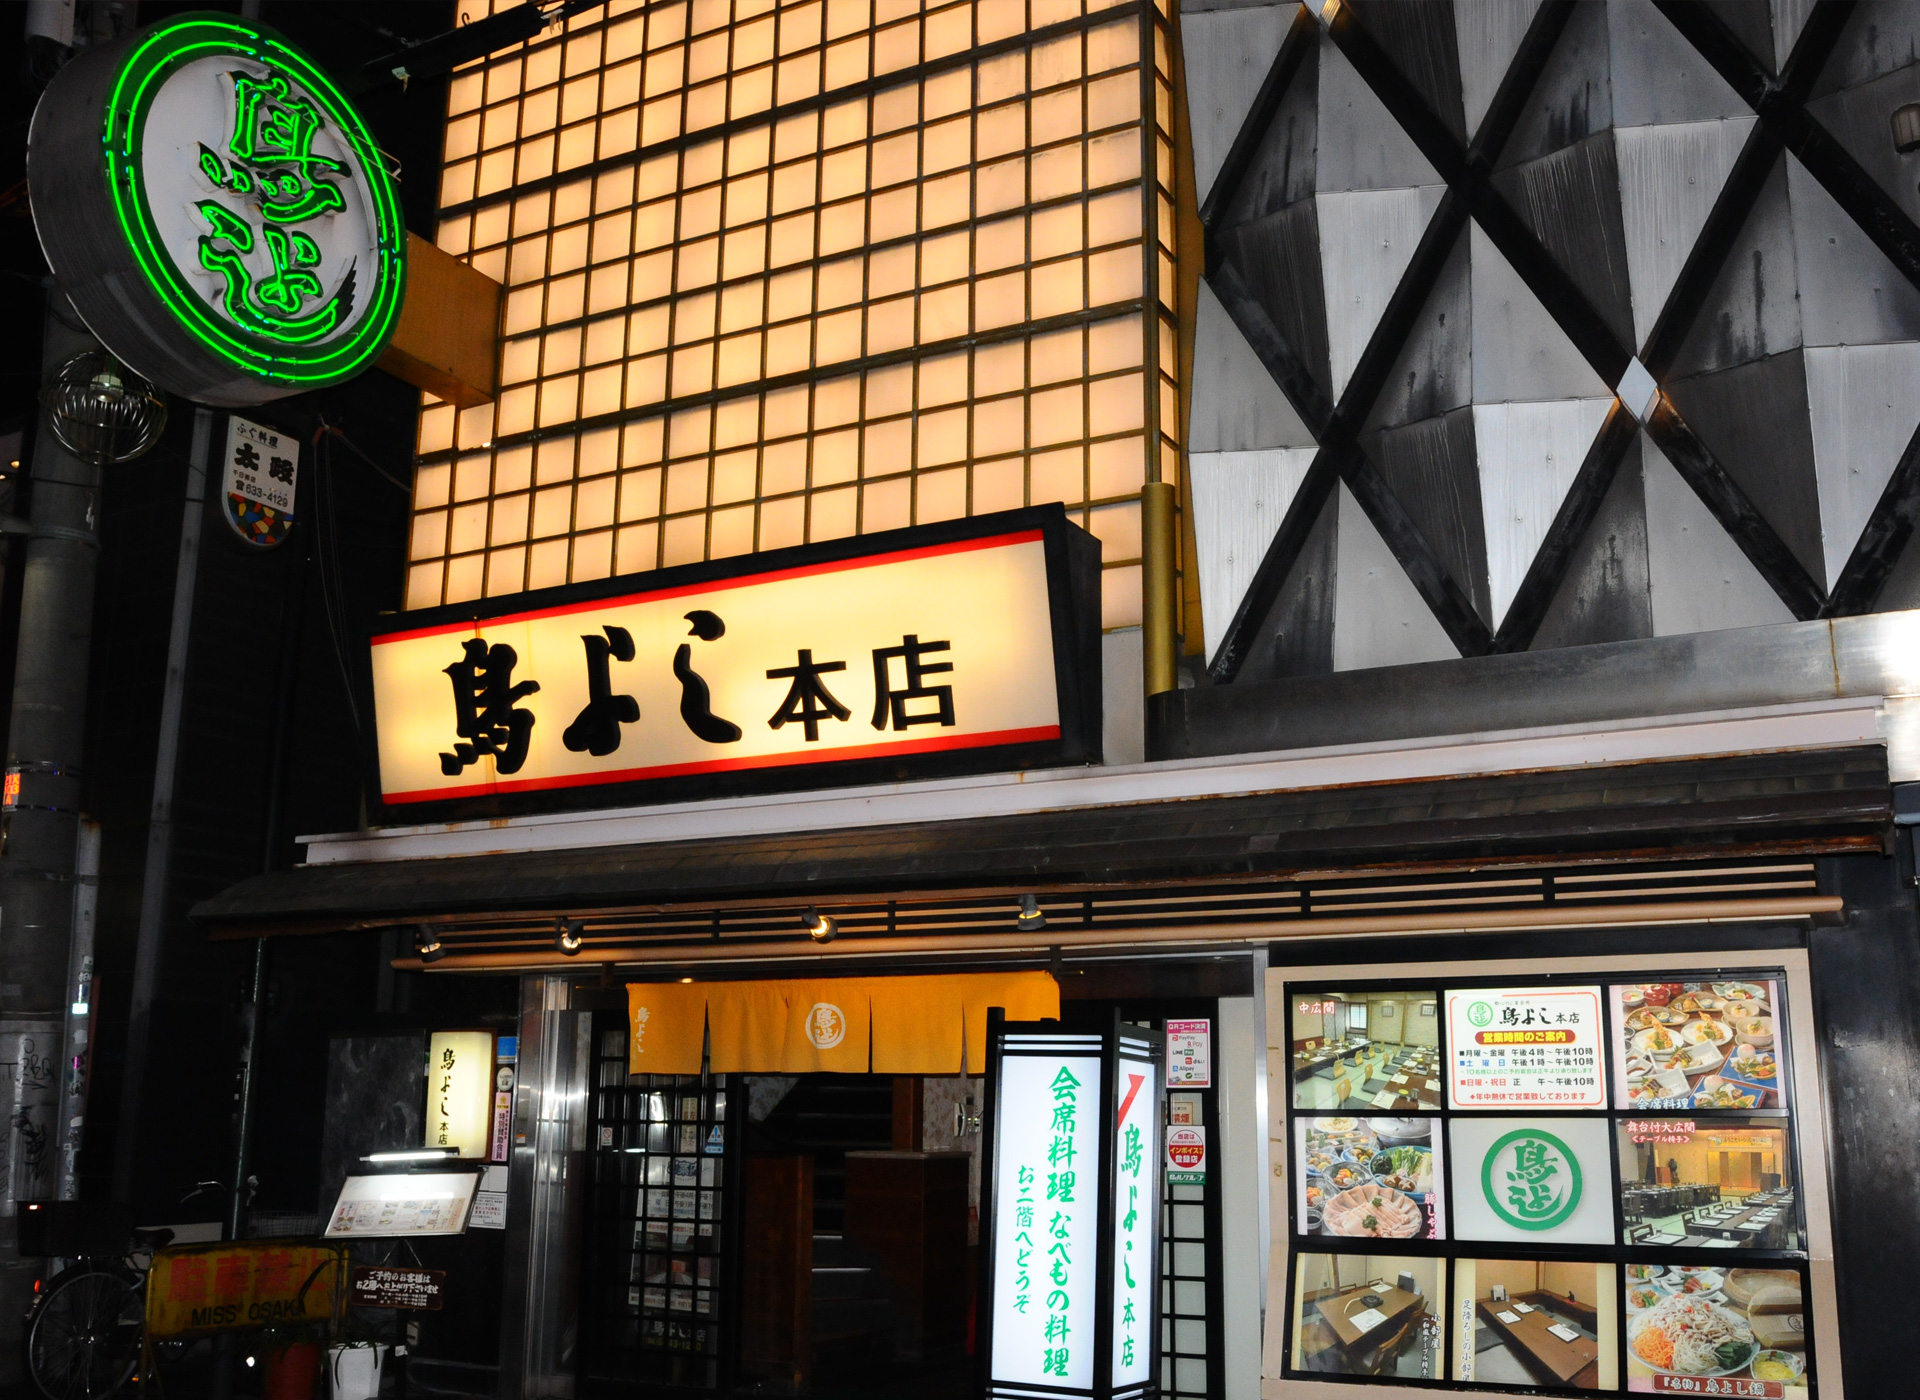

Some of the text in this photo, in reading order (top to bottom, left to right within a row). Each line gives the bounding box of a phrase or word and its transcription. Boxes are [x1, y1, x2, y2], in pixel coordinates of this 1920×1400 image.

[237, 423, 279, 448] ふぐ料理
[246, 484, 288, 507] 633-4129
[439, 610, 956, 775] 鳥よし本店
[1298, 1002, 1335, 1015] 中広間
[1499, 1007, 1580, 1026] 鳥よし本店
[1483, 1031, 1566, 1043] 営業時間のご案内
[438, 1048, 455, 1145] 鳥よし本店
[1636, 1098, 1689, 1109] 会席料理
[1626, 1121, 1695, 1134] 舞台付大広間
[1175, 1155, 1198, 1163] 登録店
[1043, 1066, 1082, 1377] 会席料理 なべもの料理
[1424, 1193, 1437, 1239] 豚しゃぶ
[1012, 1165, 1035, 1314] お二階へどうぞ
[1121, 1123, 1144, 1368] 鳥よし本店
[368, 1271, 431, 1284] ご予約のお客様は
[191, 1299, 307, 1328] MISS OSAKA
[1430, 1313, 1441, 1350] 小部屋
[1664, 1376, 1765, 1396] 『名物』鳥よし鍋
